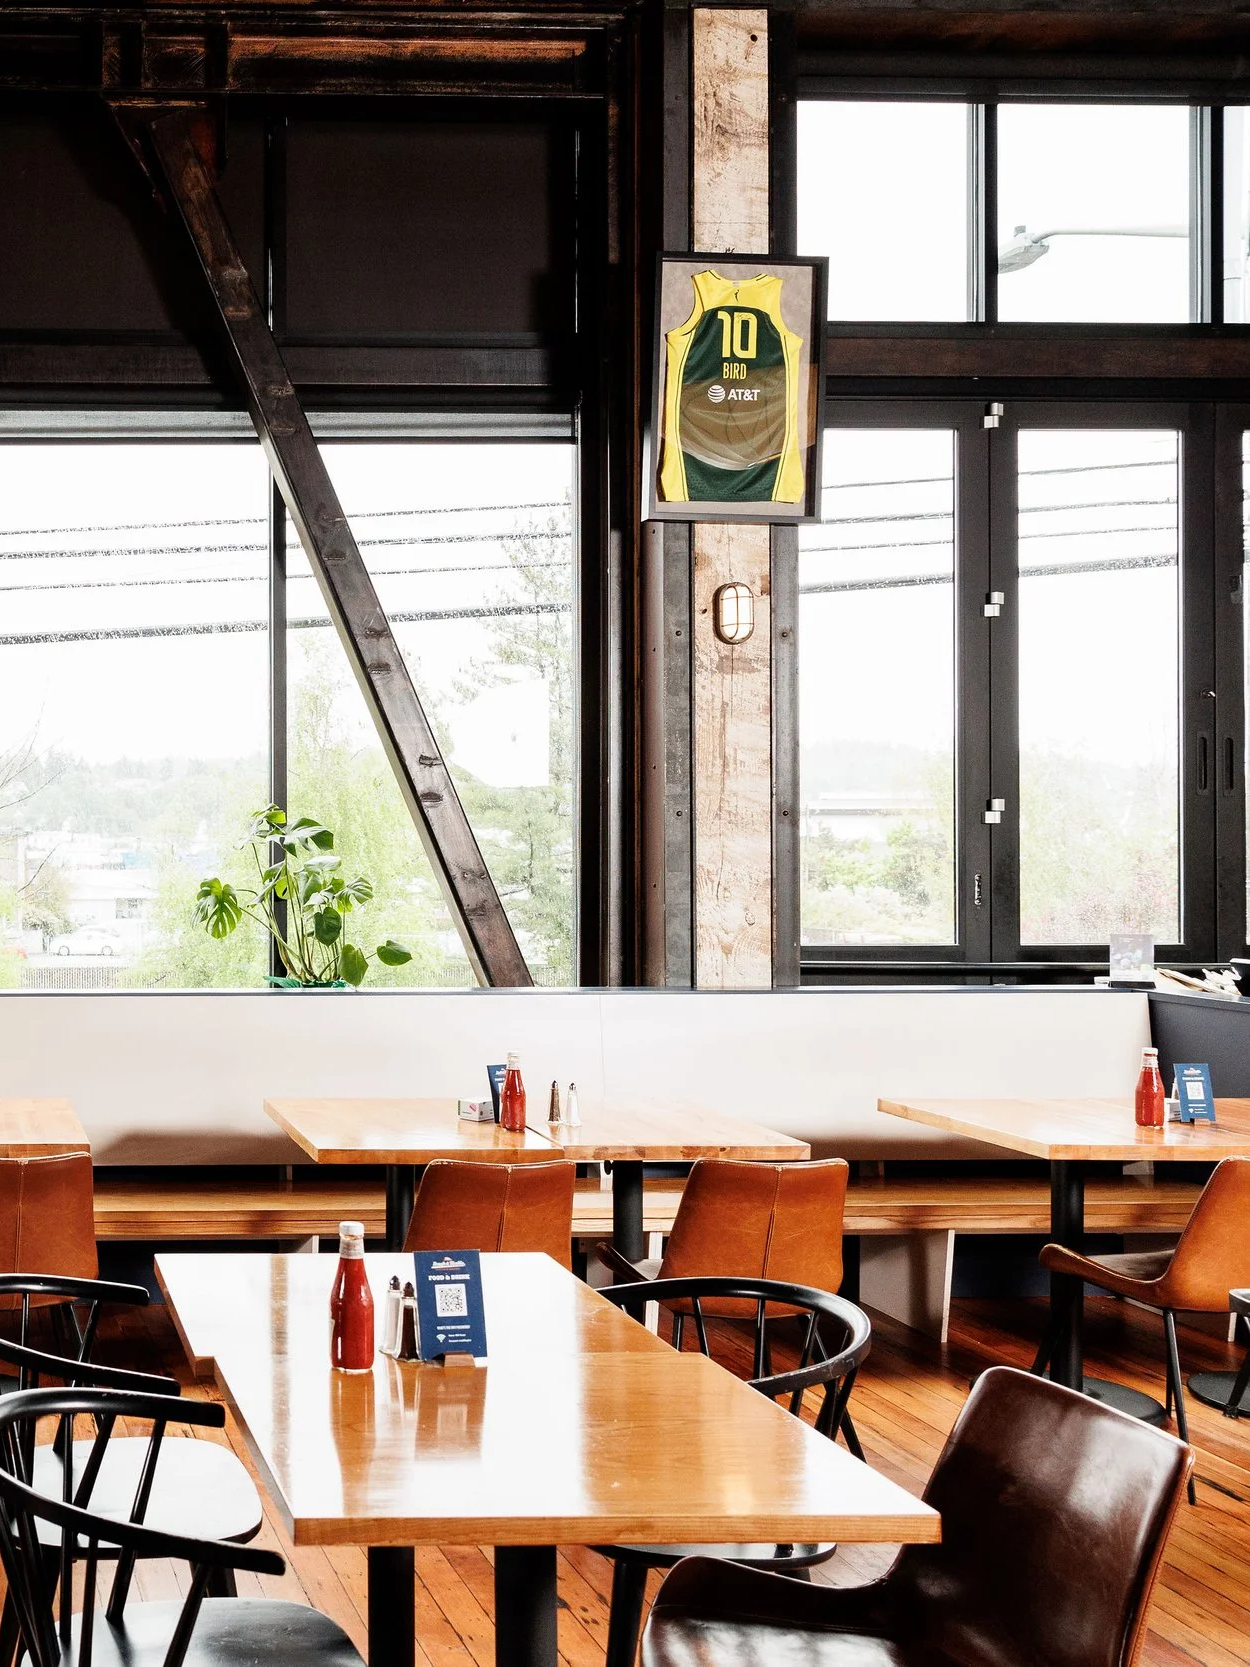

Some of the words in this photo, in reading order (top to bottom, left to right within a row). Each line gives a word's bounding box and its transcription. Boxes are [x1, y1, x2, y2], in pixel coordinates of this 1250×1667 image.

[717, 311, 757, 359] 10
[723, 362, 747, 380] BIRD
[728, 388, 761, 401] AT&T
